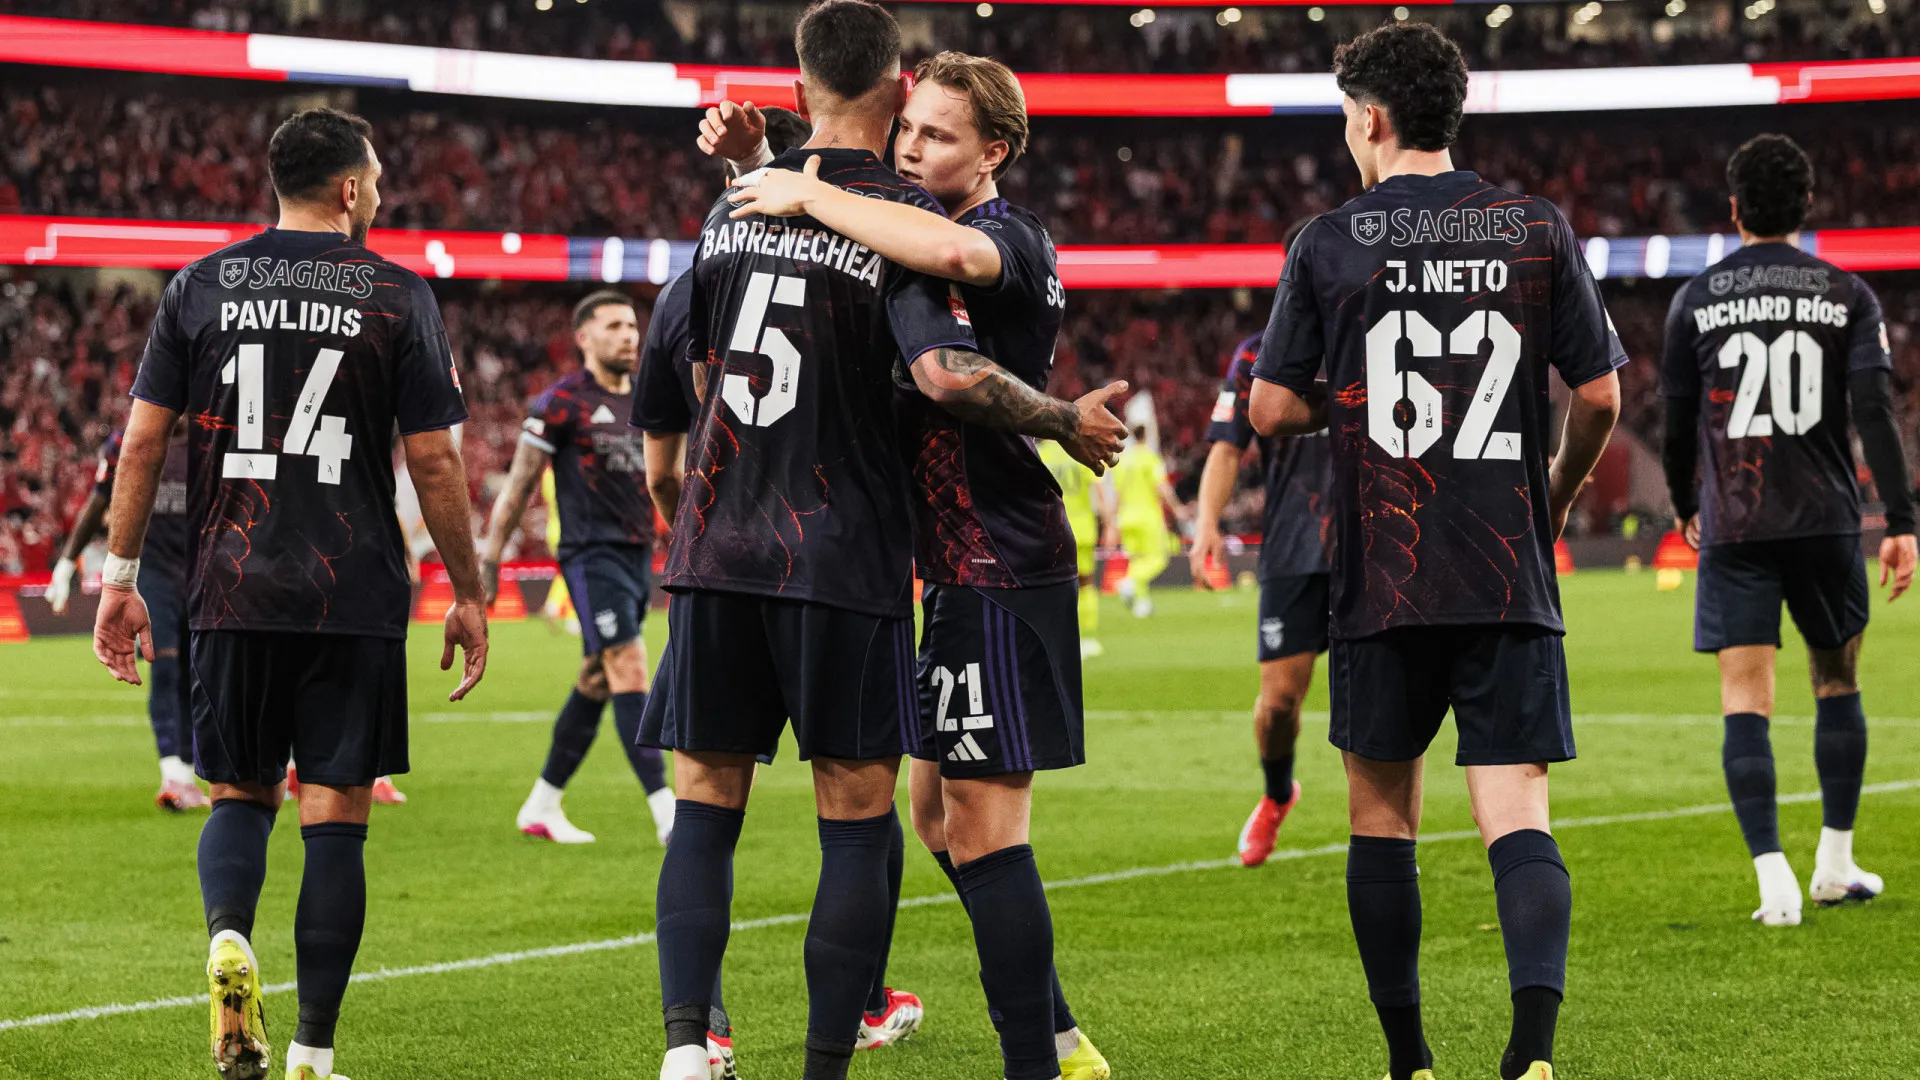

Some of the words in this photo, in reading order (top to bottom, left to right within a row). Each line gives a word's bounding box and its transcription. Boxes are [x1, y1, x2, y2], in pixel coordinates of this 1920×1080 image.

[1391, 207, 1527, 247] SAGRES
[249, 257, 375, 299] SAGRES
[703, 221, 882, 288] BARRENECHEA
[1386, 260, 1416, 293] J.
[1423, 259, 1508, 293] NETO
[1734, 265, 1830, 294] SAGRES
[221, 299, 362, 337] PAVLIDIS
[1693, 295, 1791, 333] RICHARD
[1796, 294, 1848, 328] RÍOS
[722, 271, 807, 427] 5
[1366, 310, 1522, 461] 62
[1718, 330, 1823, 439] 20
[222, 344, 353, 485] 14
[931, 663, 994, 732] 21
